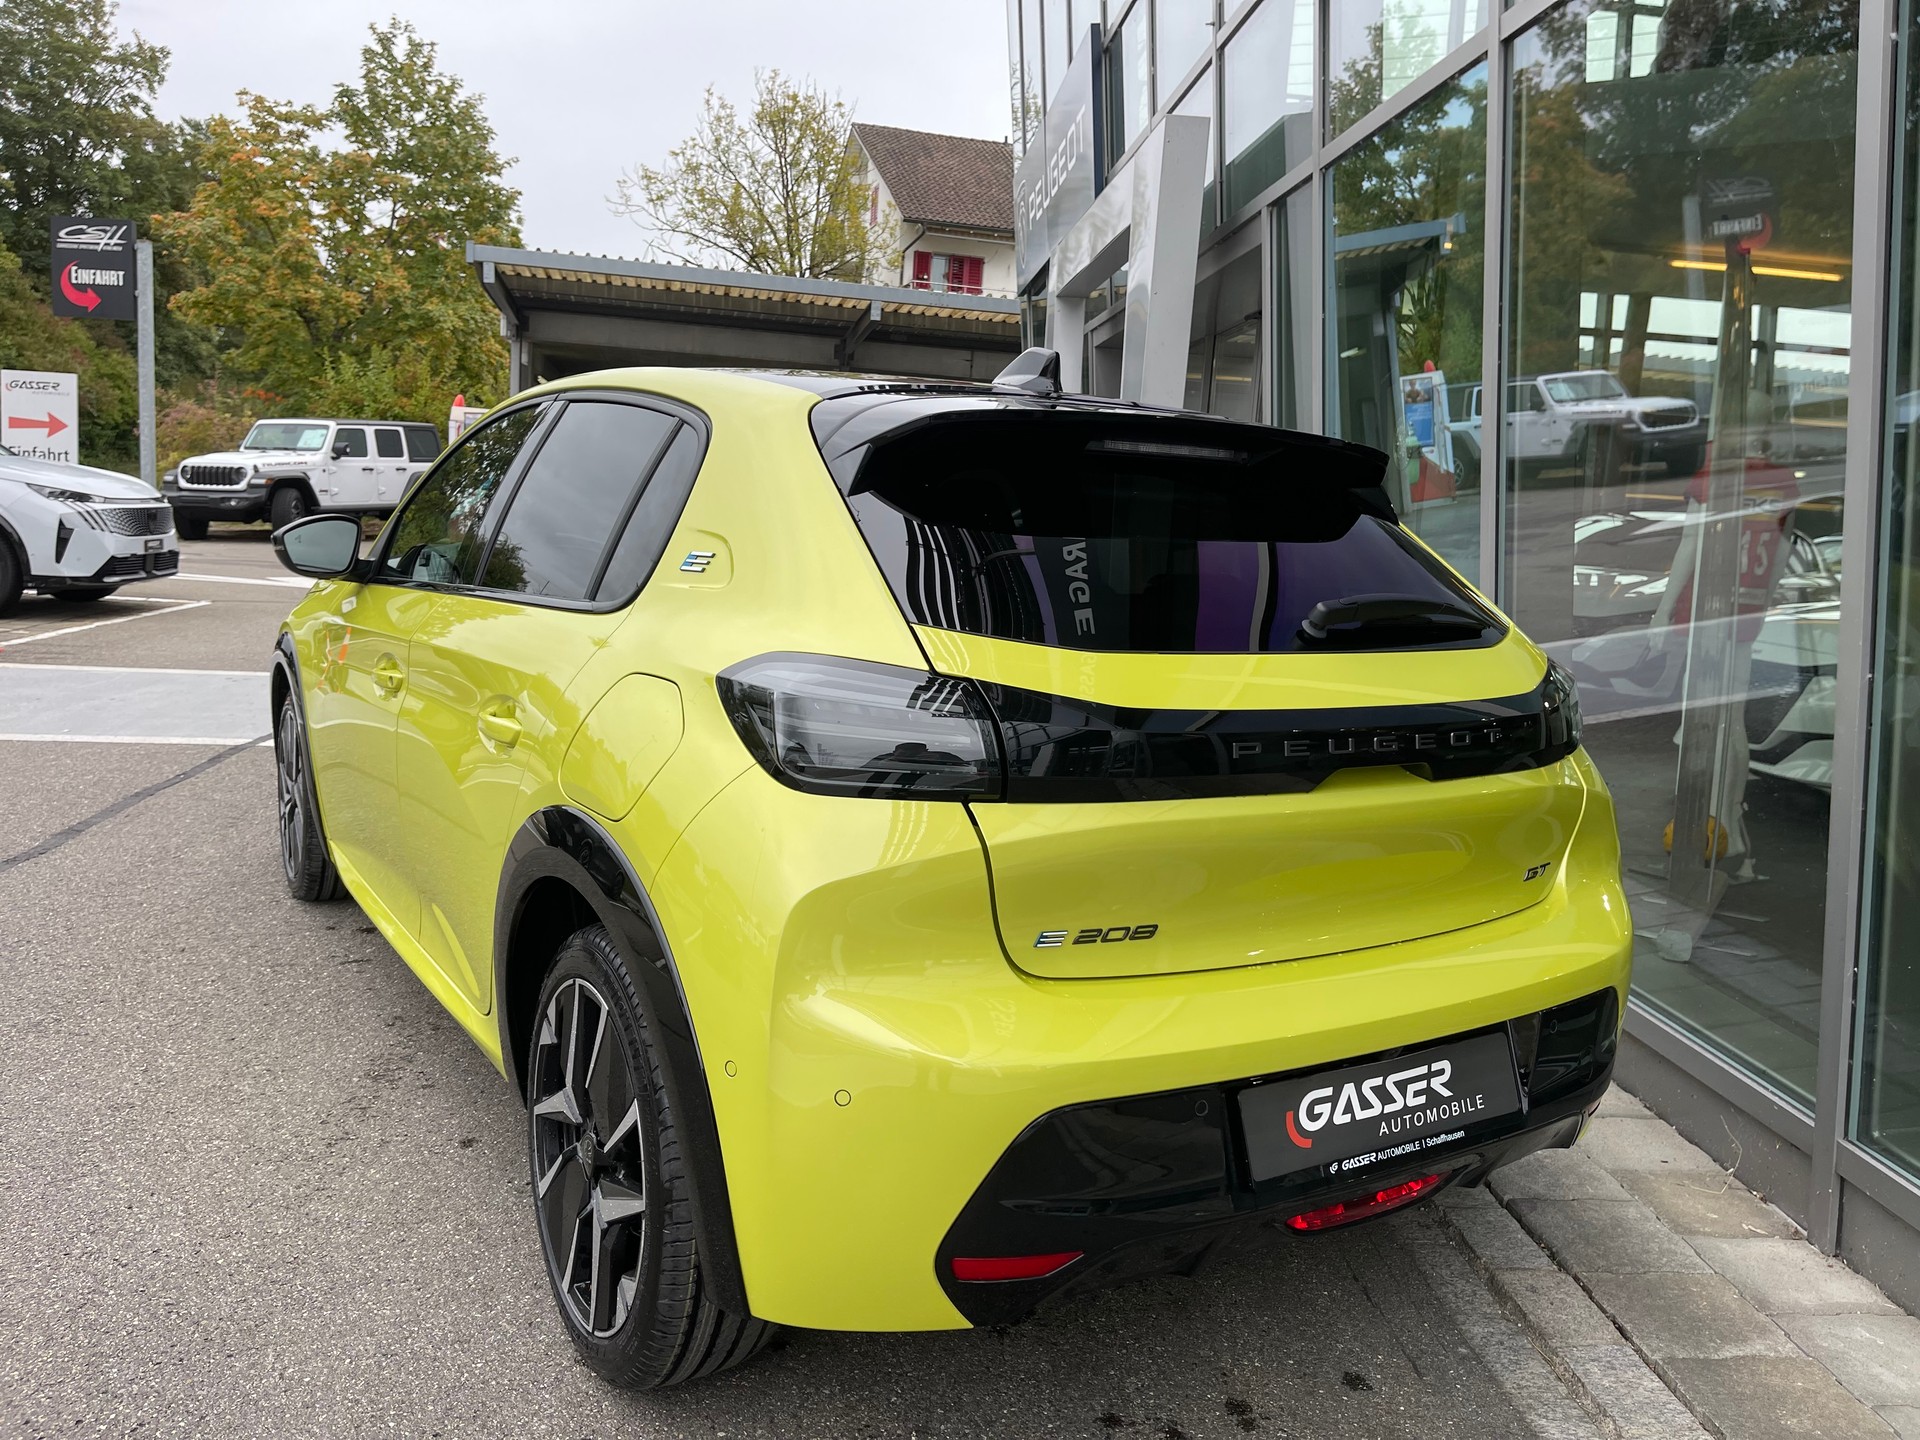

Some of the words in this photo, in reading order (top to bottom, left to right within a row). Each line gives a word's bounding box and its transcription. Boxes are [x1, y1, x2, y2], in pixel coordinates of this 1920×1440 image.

[1029, 104, 1086, 231] PEUGEOT
[9, 380, 60, 391] GASSER
[1232, 728, 1503, 759] PEUGEOT
[1523, 861, 1551, 882] GT
[1072, 924, 1158, 945] 208
[1299, 1060, 1453, 1132] GASSER
[1379, 1094, 1485, 1136] AUTOMOBILE
[1342, 1152, 1376, 1171] GASSER
[1377, 1141, 1420, 1161] AUTOMOBILE
[1426, 1130, 1465, 1147] Schaffhausen
